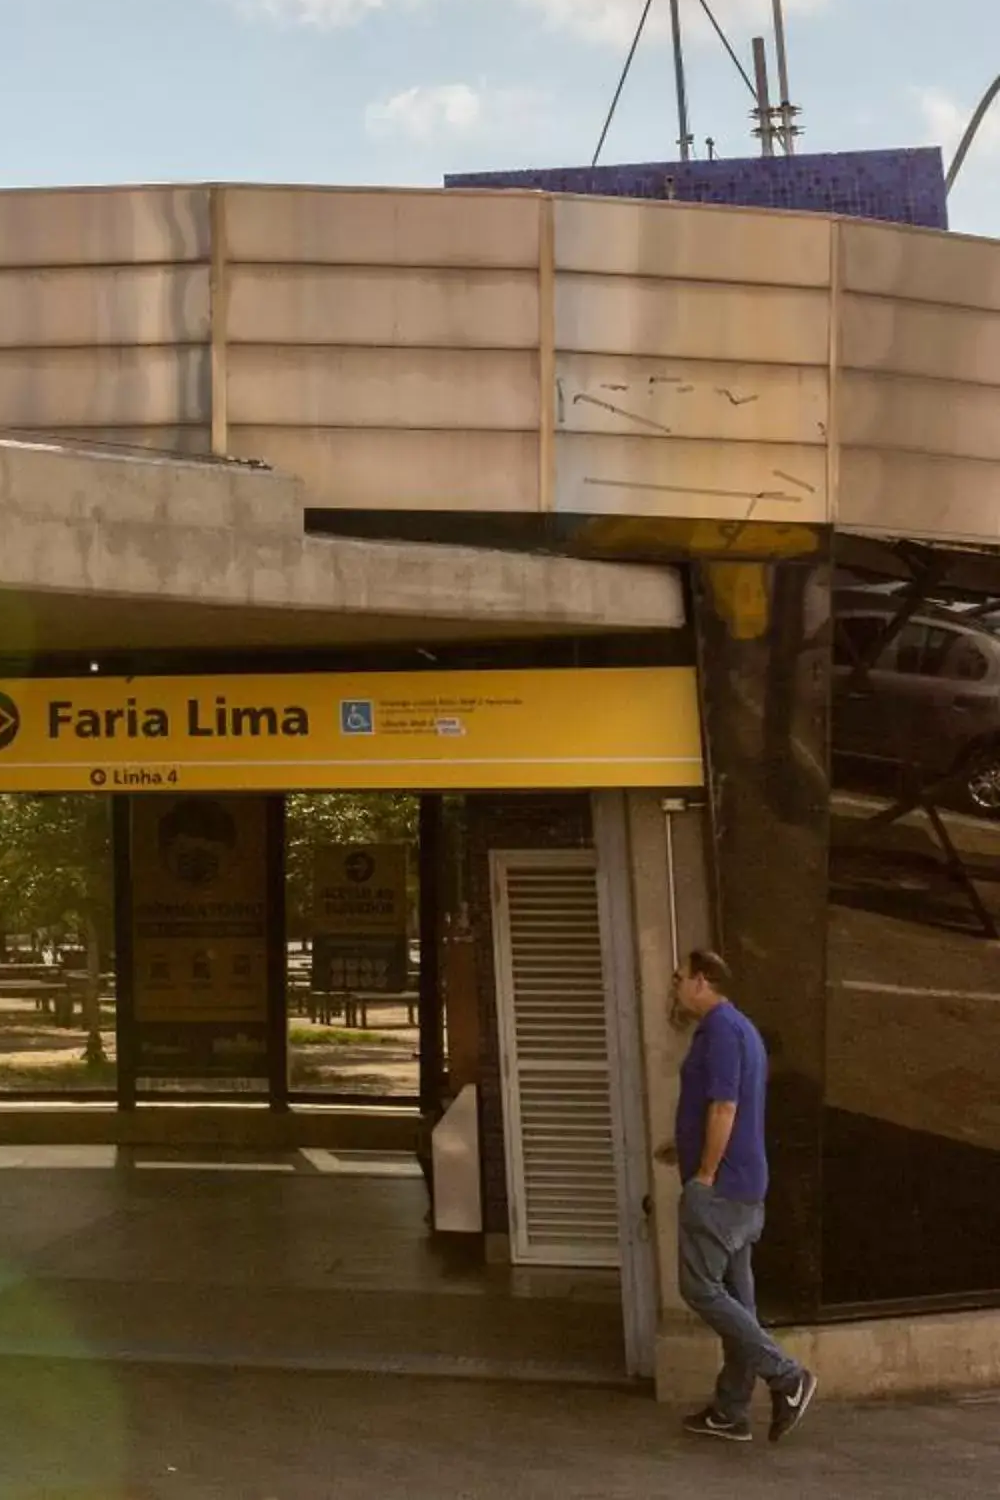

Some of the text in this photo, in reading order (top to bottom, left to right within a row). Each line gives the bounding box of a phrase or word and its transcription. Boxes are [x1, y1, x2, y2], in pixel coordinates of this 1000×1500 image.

[48, 696, 309, 738] Faria Lima
[113, 769, 178, 785] Linha 4
